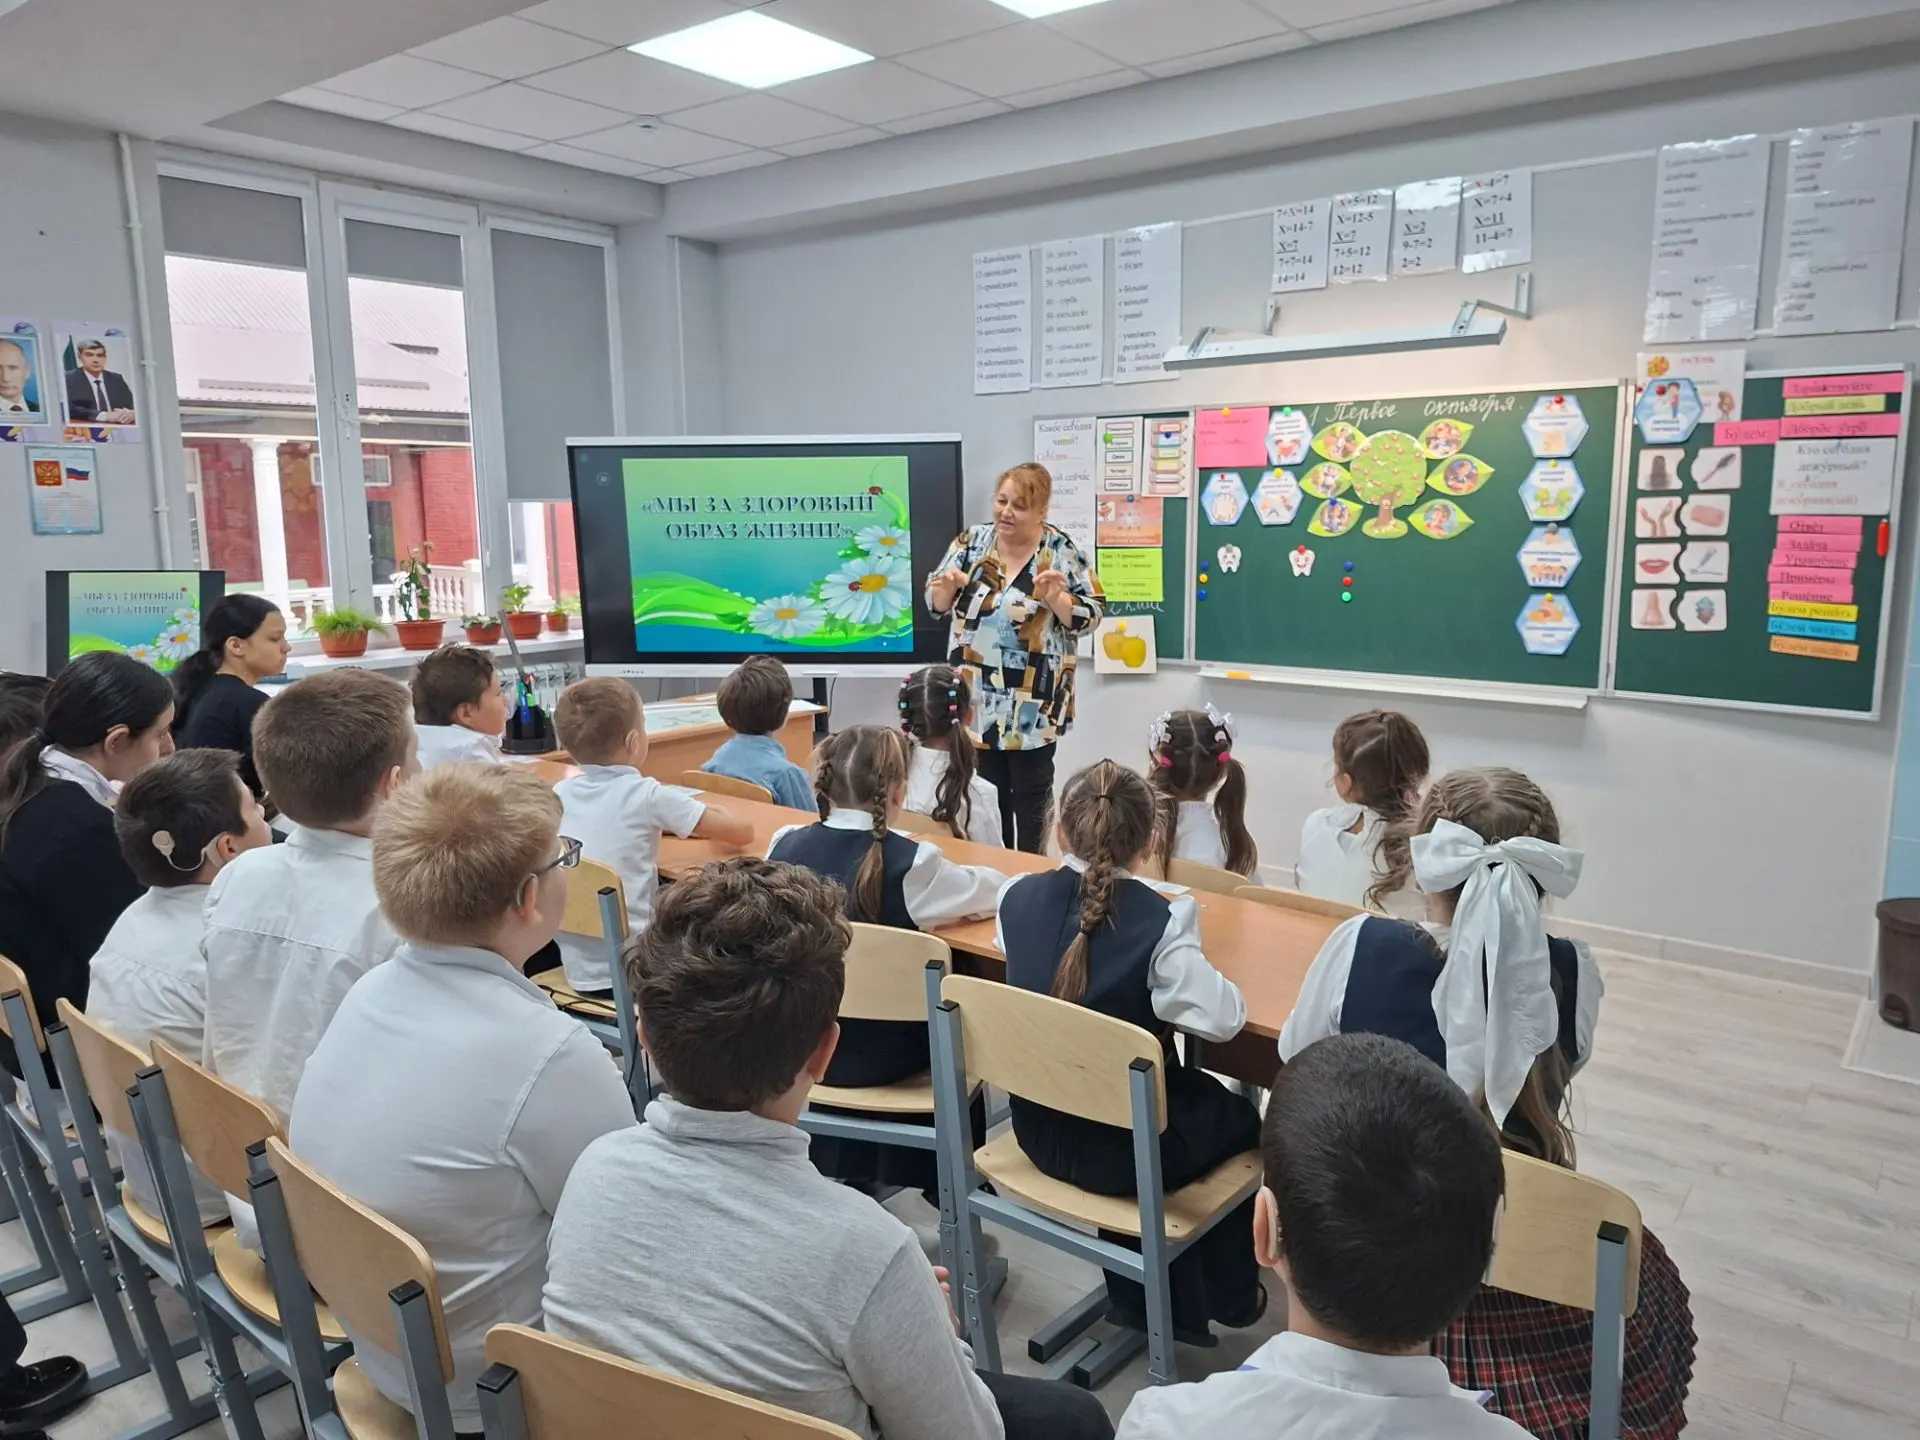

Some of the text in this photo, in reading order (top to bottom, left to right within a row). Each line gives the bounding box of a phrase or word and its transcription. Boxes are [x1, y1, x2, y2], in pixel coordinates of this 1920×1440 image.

[1325, 400, 1398, 428] Первое
[642, 491, 876, 517] «МЫ ЗА ЗДОРОВЫЙ
[665, 522, 739, 540] ОБРАЗ
